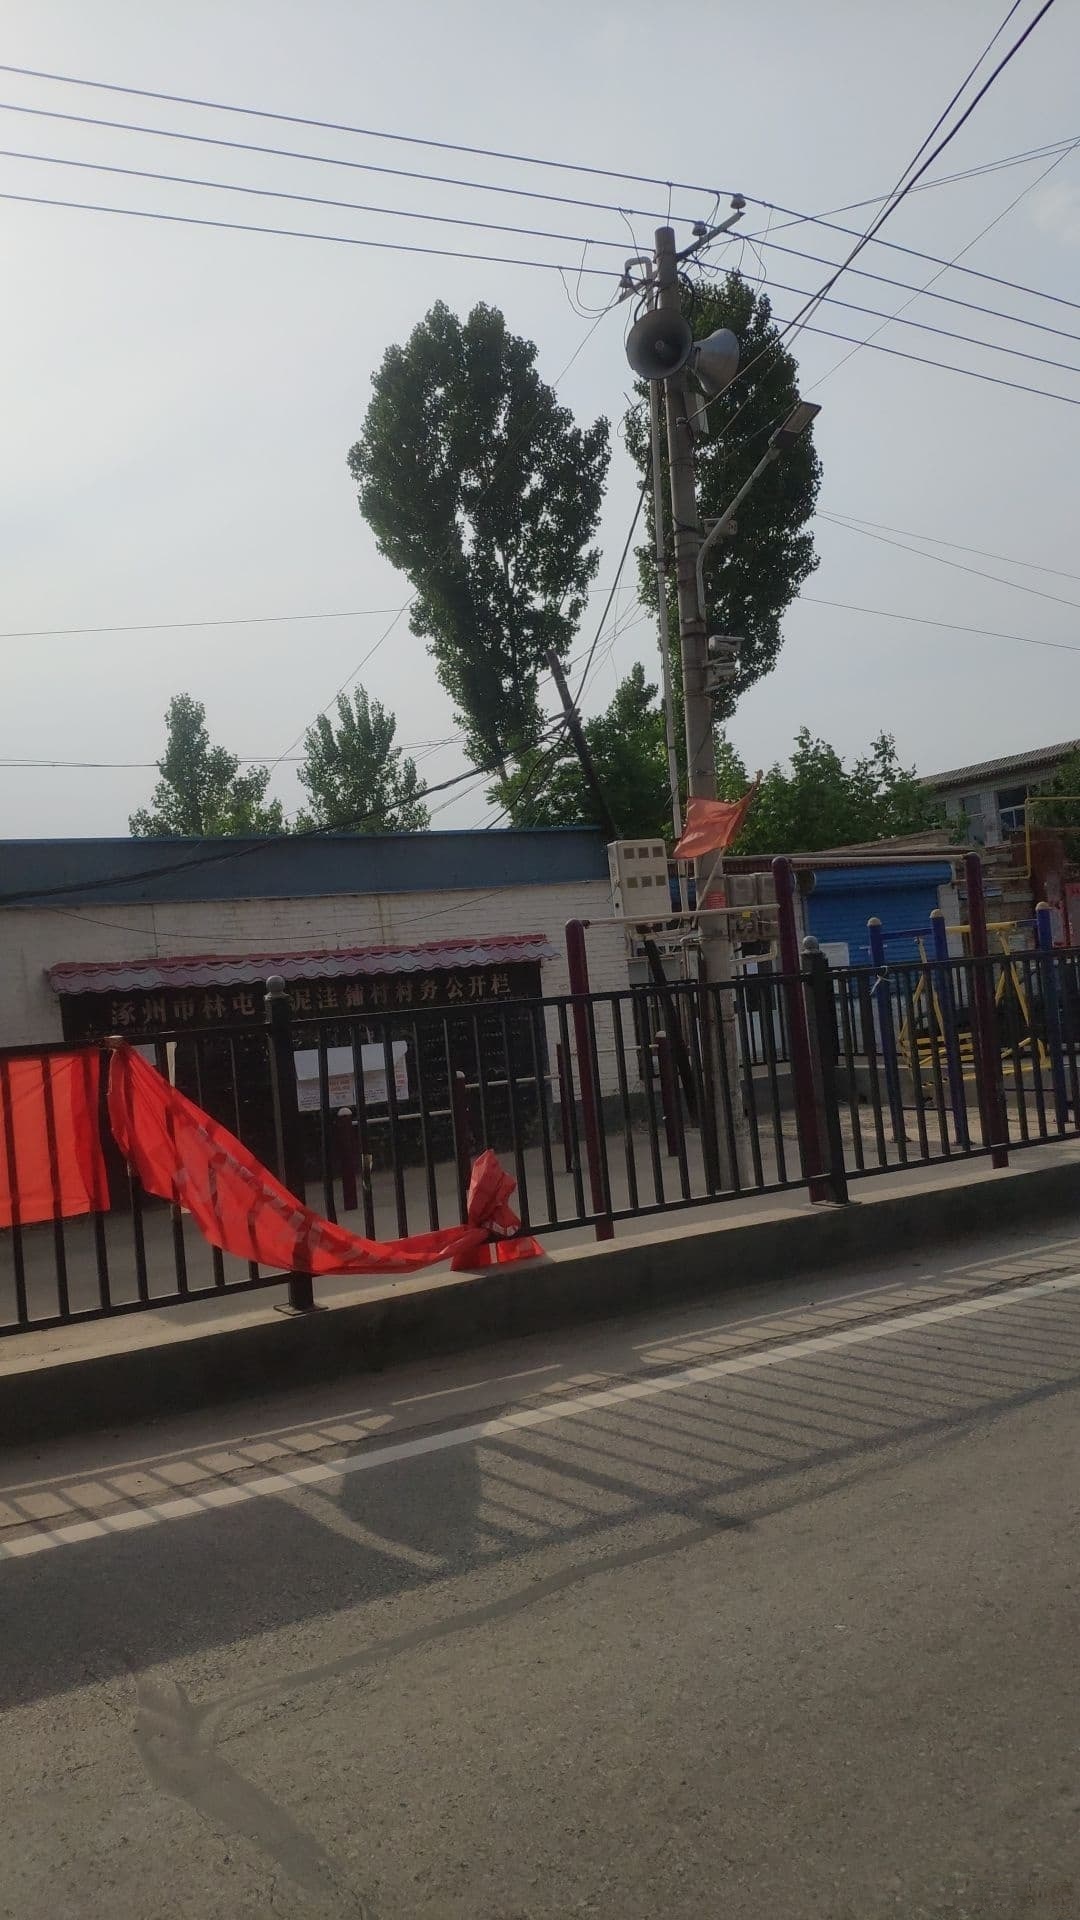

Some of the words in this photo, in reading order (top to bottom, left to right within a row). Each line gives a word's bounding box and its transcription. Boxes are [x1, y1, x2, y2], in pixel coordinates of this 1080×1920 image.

[111, 972, 511, 1026] 涿州市林屯泥洼铺村村务公开栏
